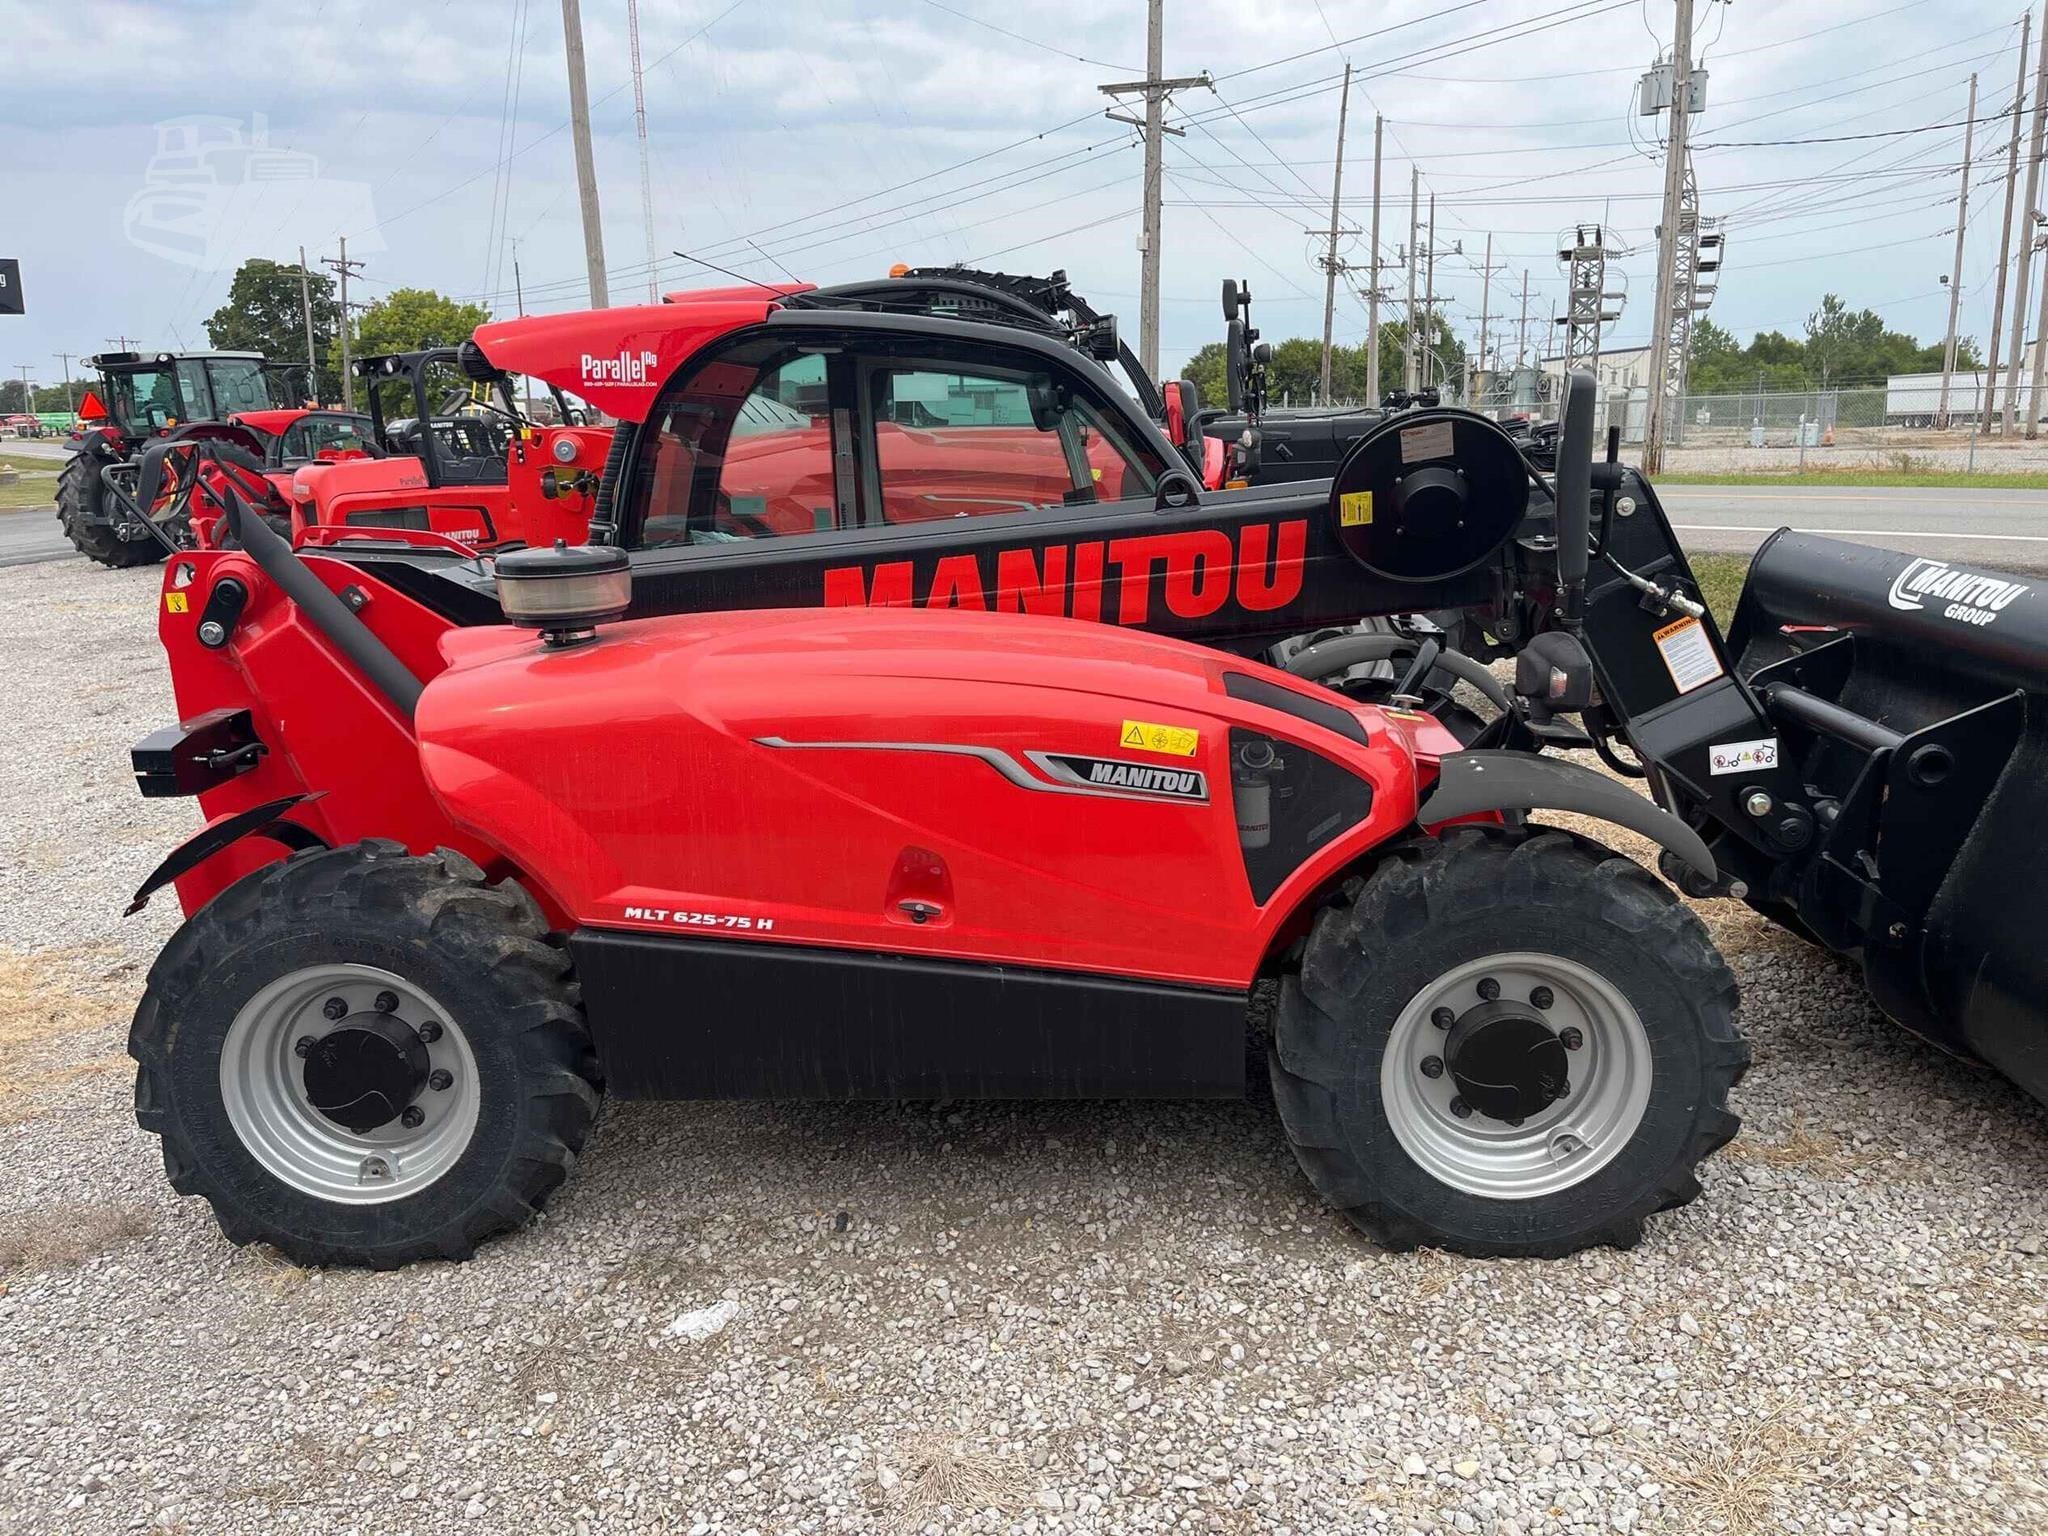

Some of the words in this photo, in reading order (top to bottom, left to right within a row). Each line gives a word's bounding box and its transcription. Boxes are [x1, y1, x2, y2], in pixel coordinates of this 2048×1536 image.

[1906, 566, 2029, 611] MANITOU
[1944, 603, 1997, 626] GROUP
[1089, 763, 1196, 793] MANITOU
[624, 907, 669, 921] MLT
[673, 911, 751, 929] 625-75
[756, 918, 774, 930] H
